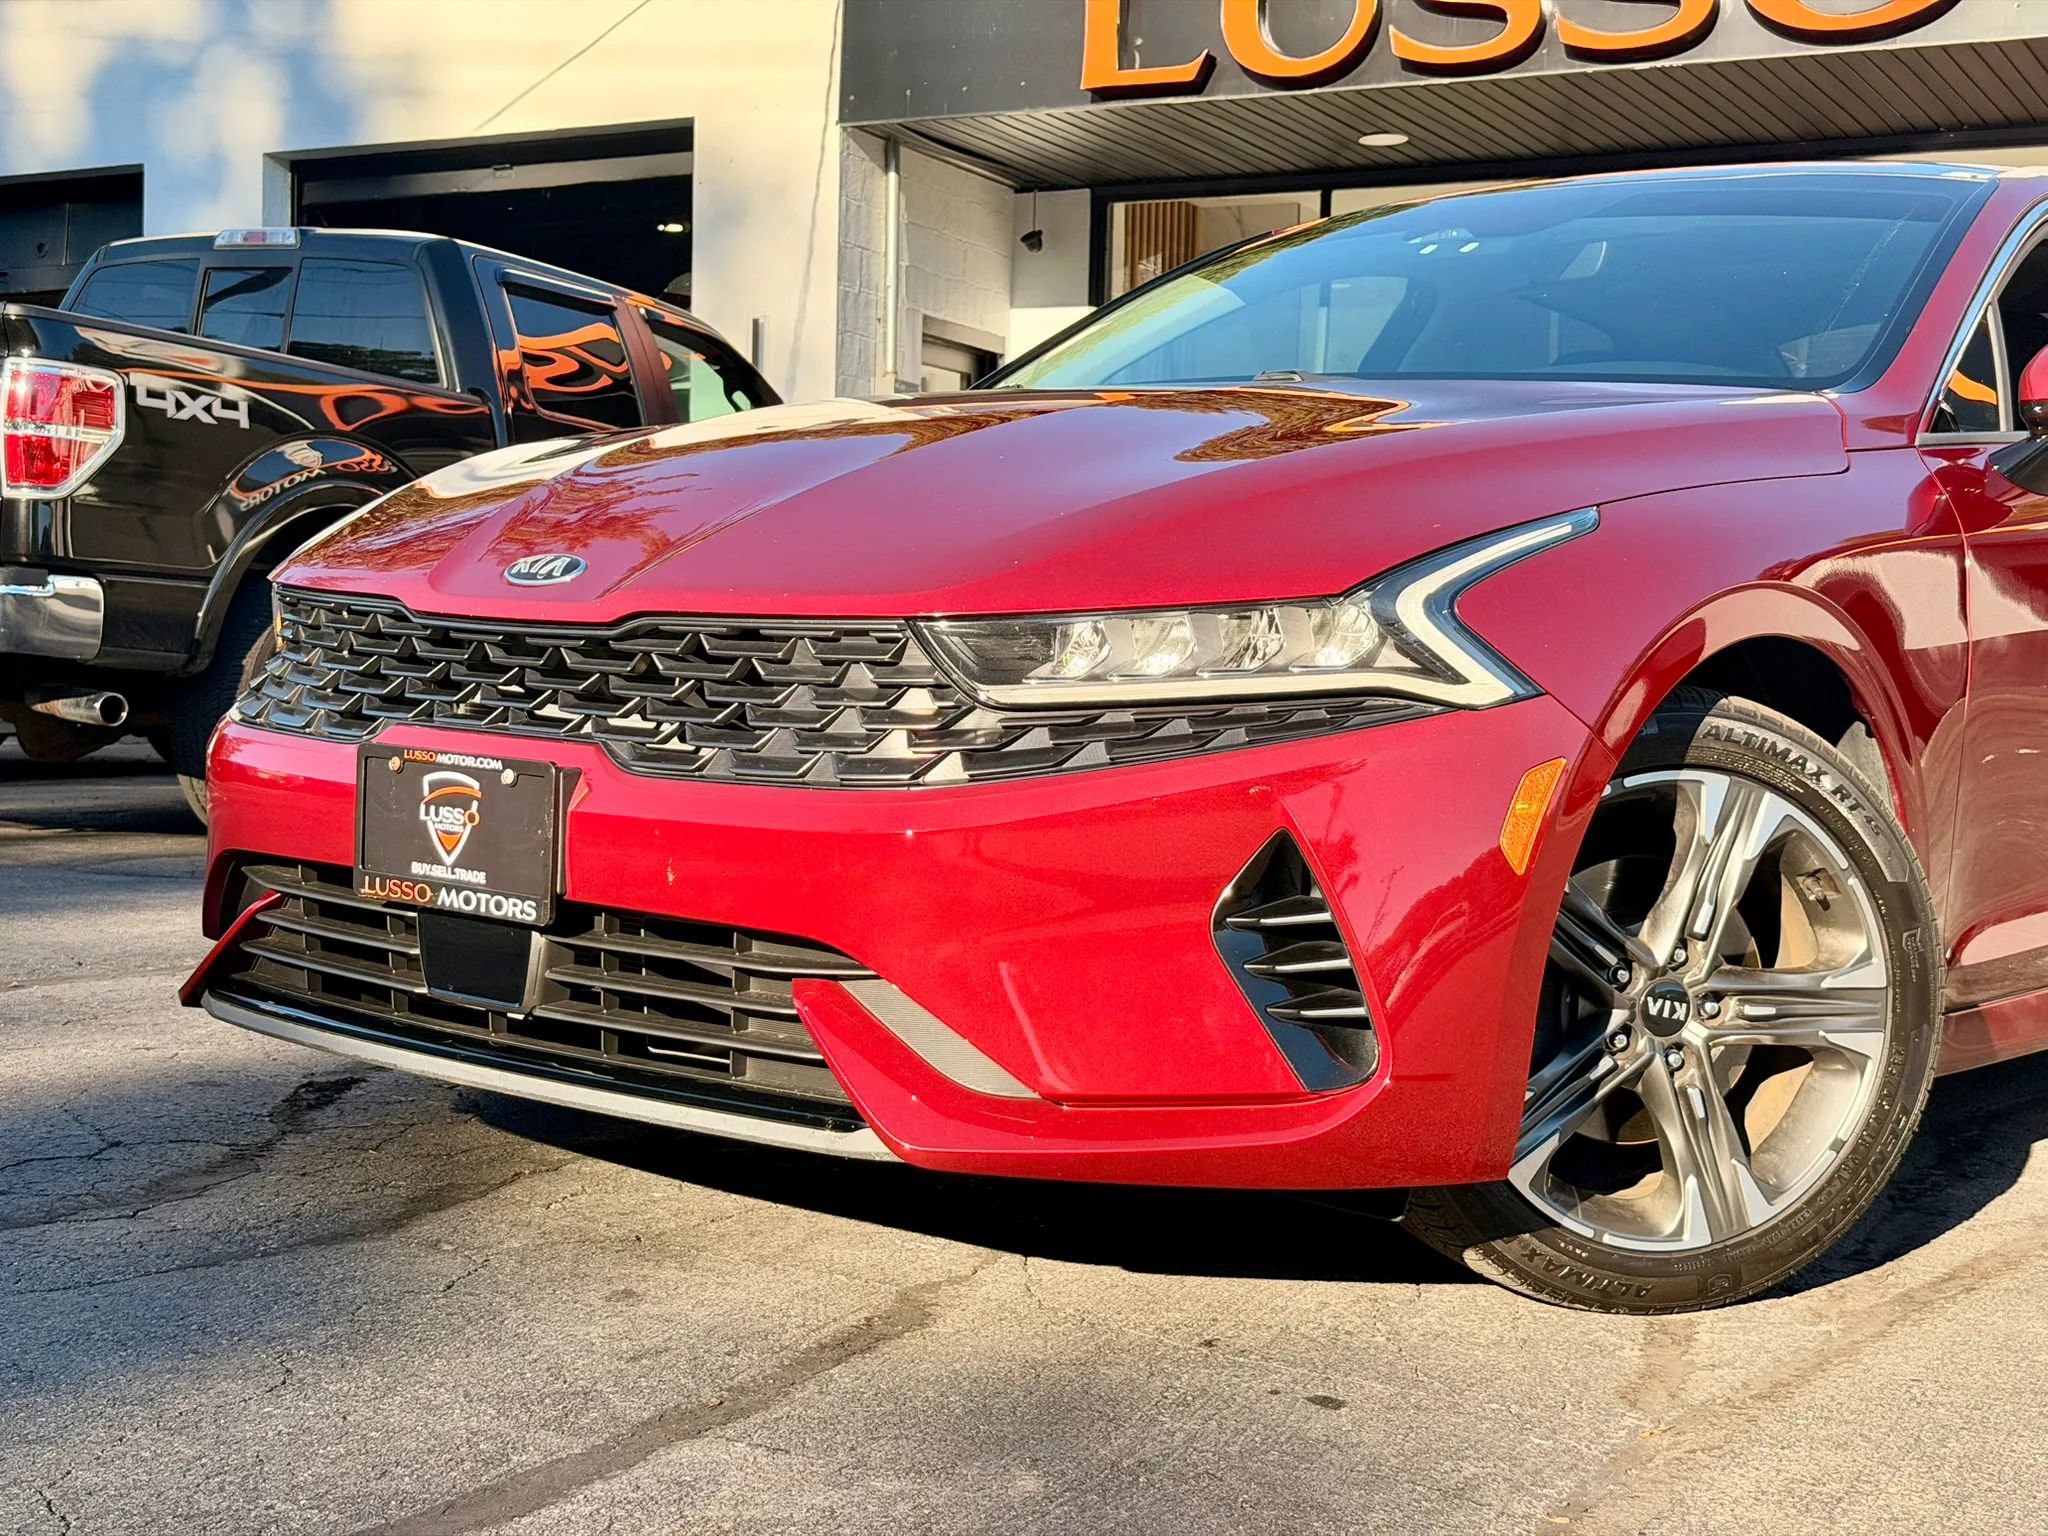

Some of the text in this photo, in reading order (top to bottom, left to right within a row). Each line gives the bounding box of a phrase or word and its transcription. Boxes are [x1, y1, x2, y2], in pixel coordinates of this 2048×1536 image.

[511, 556, 571, 578] KIA
[1700, 724, 1829, 780] ALTIMAX
[420, 803, 480, 826] LUSSO
[434, 822, 464, 833] MOTORS
[362, 876, 537, 921] LUSSO MOTORS
[1647, 996, 1688, 1021] KIA
[1520, 1247, 1655, 1297] ALTIMAX
